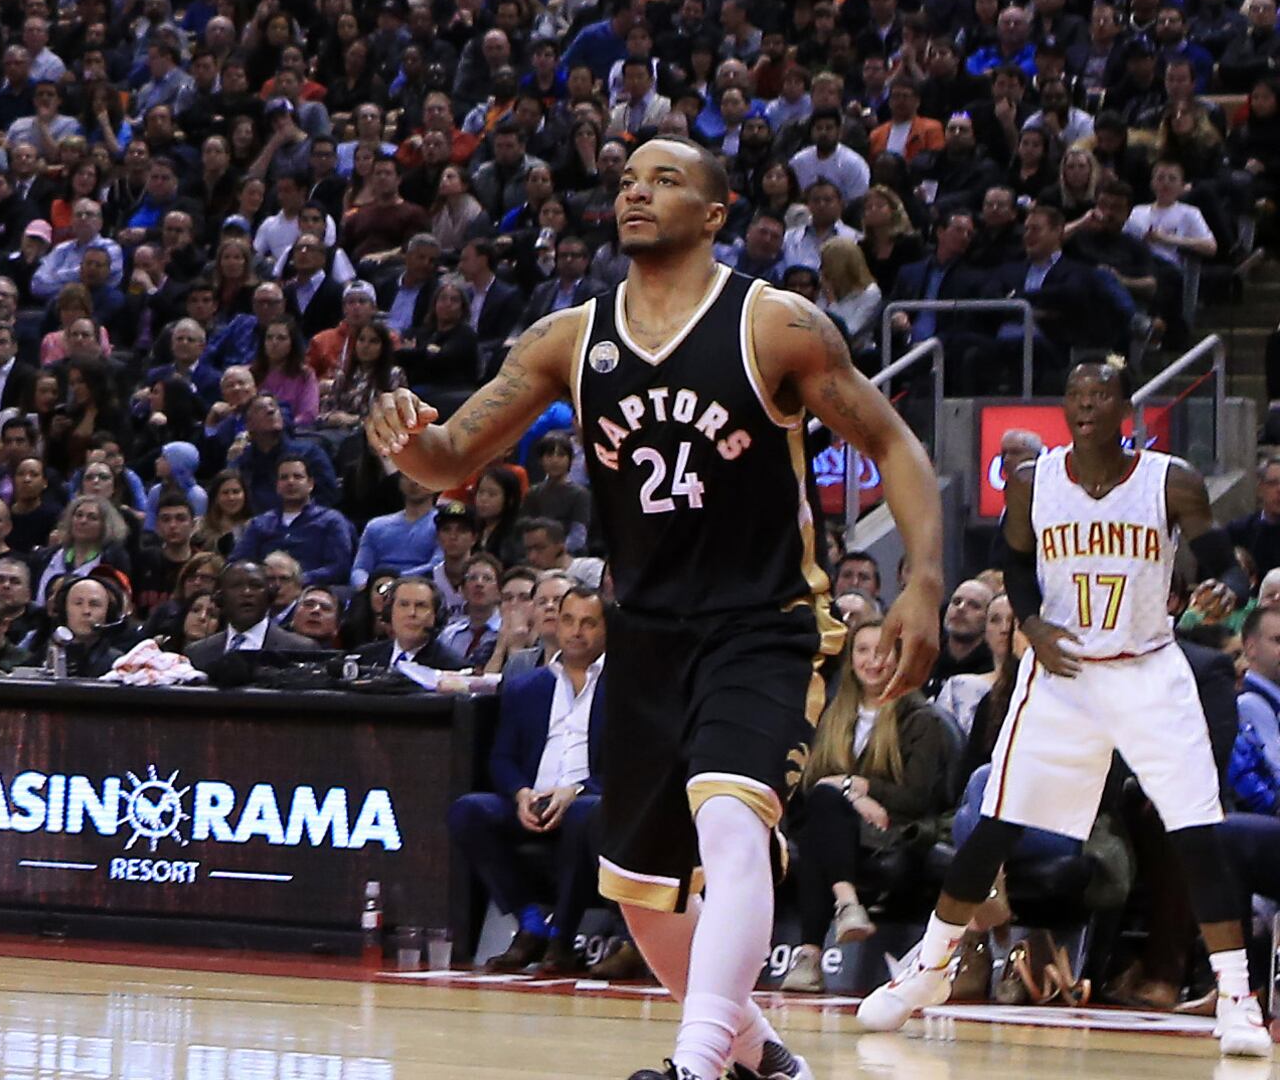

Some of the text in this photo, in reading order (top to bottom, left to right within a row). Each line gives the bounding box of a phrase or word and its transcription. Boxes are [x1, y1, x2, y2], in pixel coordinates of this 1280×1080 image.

[593, 387, 752, 470] RAPTORS
[632, 442, 705, 514] 24
[1042, 520, 1160, 561] ATLANTA
[1072, 573, 1128, 631] 17
[110, 858, 200, 884] RESORT
